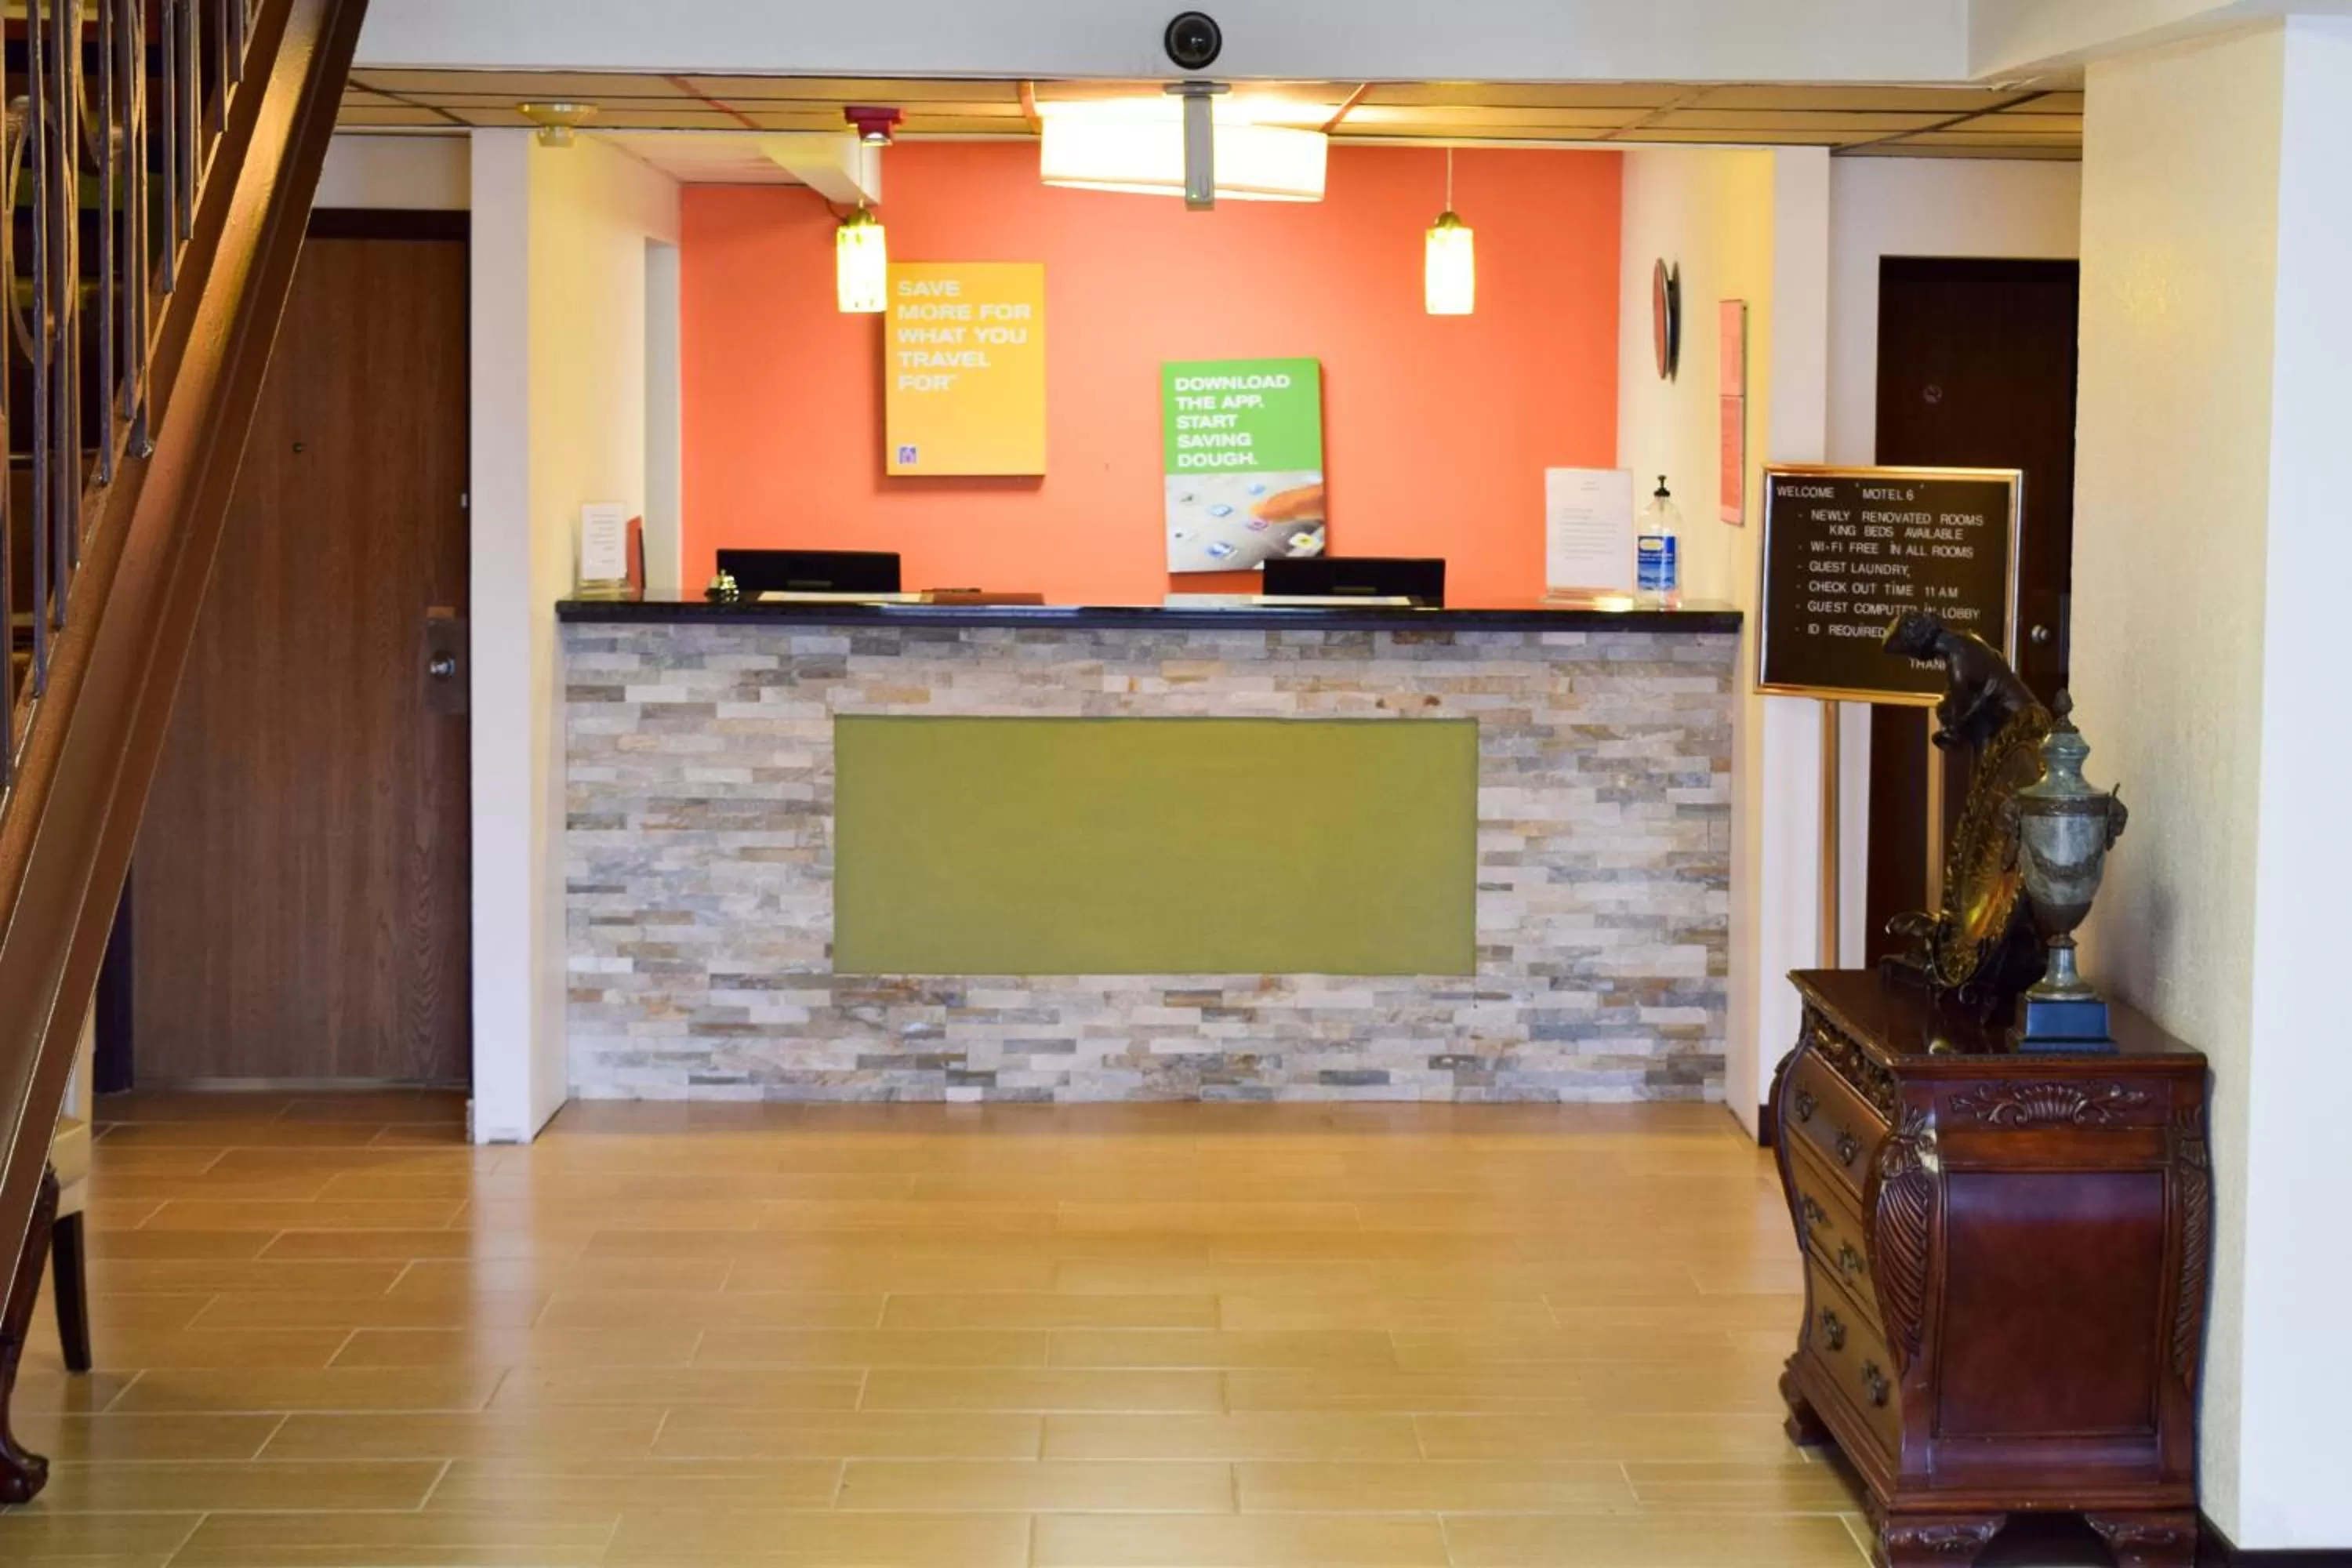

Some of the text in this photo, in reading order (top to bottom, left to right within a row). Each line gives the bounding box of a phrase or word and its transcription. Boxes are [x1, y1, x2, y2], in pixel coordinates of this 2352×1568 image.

[898, 281, 960, 296] SAVE
[898, 304, 1031, 320] MORE FOR
[898, 328, 1027, 343] WHAT YOU
[898, 351, 991, 368] TRAVEL
[1175, 375, 1290, 391] DOWNLOAD
[1175, 395, 1264, 409] THE APP.
[1177, 415, 1238, 429] START
[1178, 433, 1253, 448] SAVING
[1178, 452, 1258, 467] DOUGH.
[1777, 486, 1835, 499] WELCOME
[1906, 489, 1915, 500] 6
[1811, 510, 1984, 525] NEWLY RENOVATED ROOMS
[1829, 525, 1963, 540] KING BEDS AVAILABLE
[1849, 543, 1879, 554] FREE
[1906, 545, 1926, 557] ALL
[1932, 546, 1973, 557] ROOMS
[1809, 561, 1846, 572] GUEST
[1809, 583, 1846, 593] CHECK
[1852, 583, 1877, 595] OUT
[1925, 586, 1935, 597] 11
[1808, 601, 1848, 612] GUEST
[1941, 608, 1981, 620] LOBBY
[1808, 625, 1820, 635] ID
[1910, 659, 1946, 671] THAN
